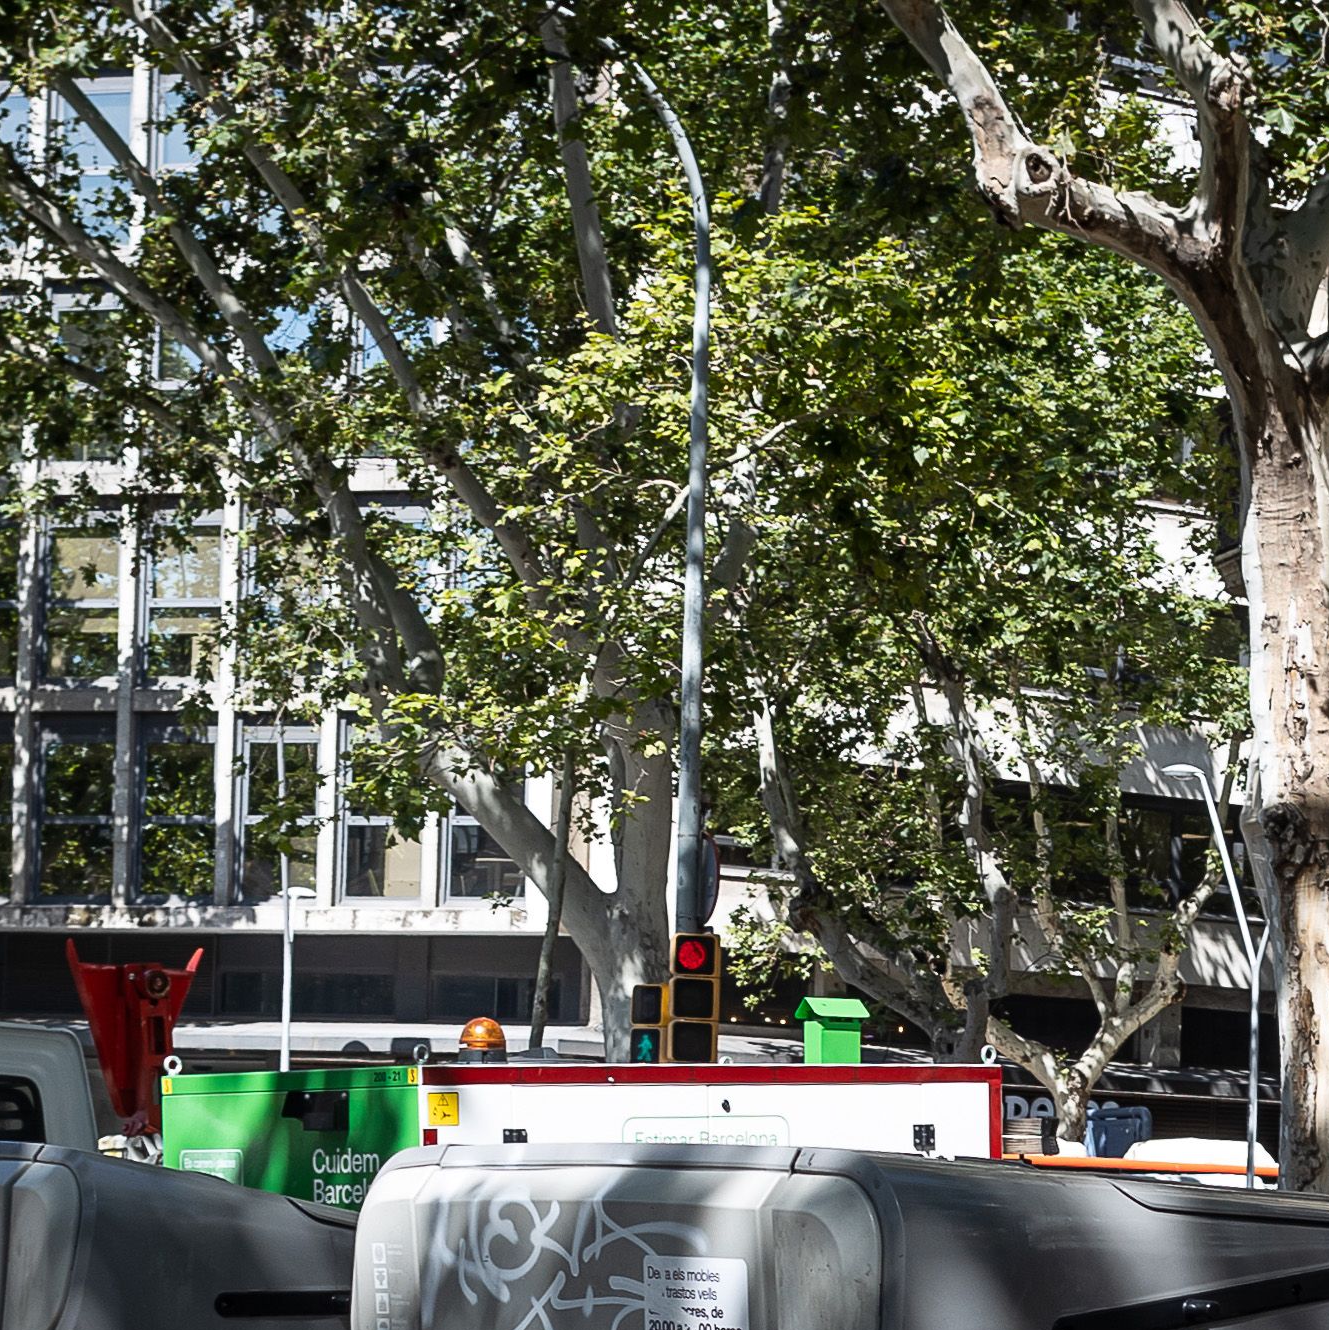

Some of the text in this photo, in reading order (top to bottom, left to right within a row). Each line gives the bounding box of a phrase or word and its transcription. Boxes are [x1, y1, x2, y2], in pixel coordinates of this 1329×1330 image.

[312, 1147, 379, 1174] Cuidem
[313, 1178, 370, 1204] Barcel
[673, 1267, 685, 1281] els
[687, 1268, 720, 1283] mobles
[666, 1287, 718, 1301] trastos vells
[711, 1306, 724, 1319] de
